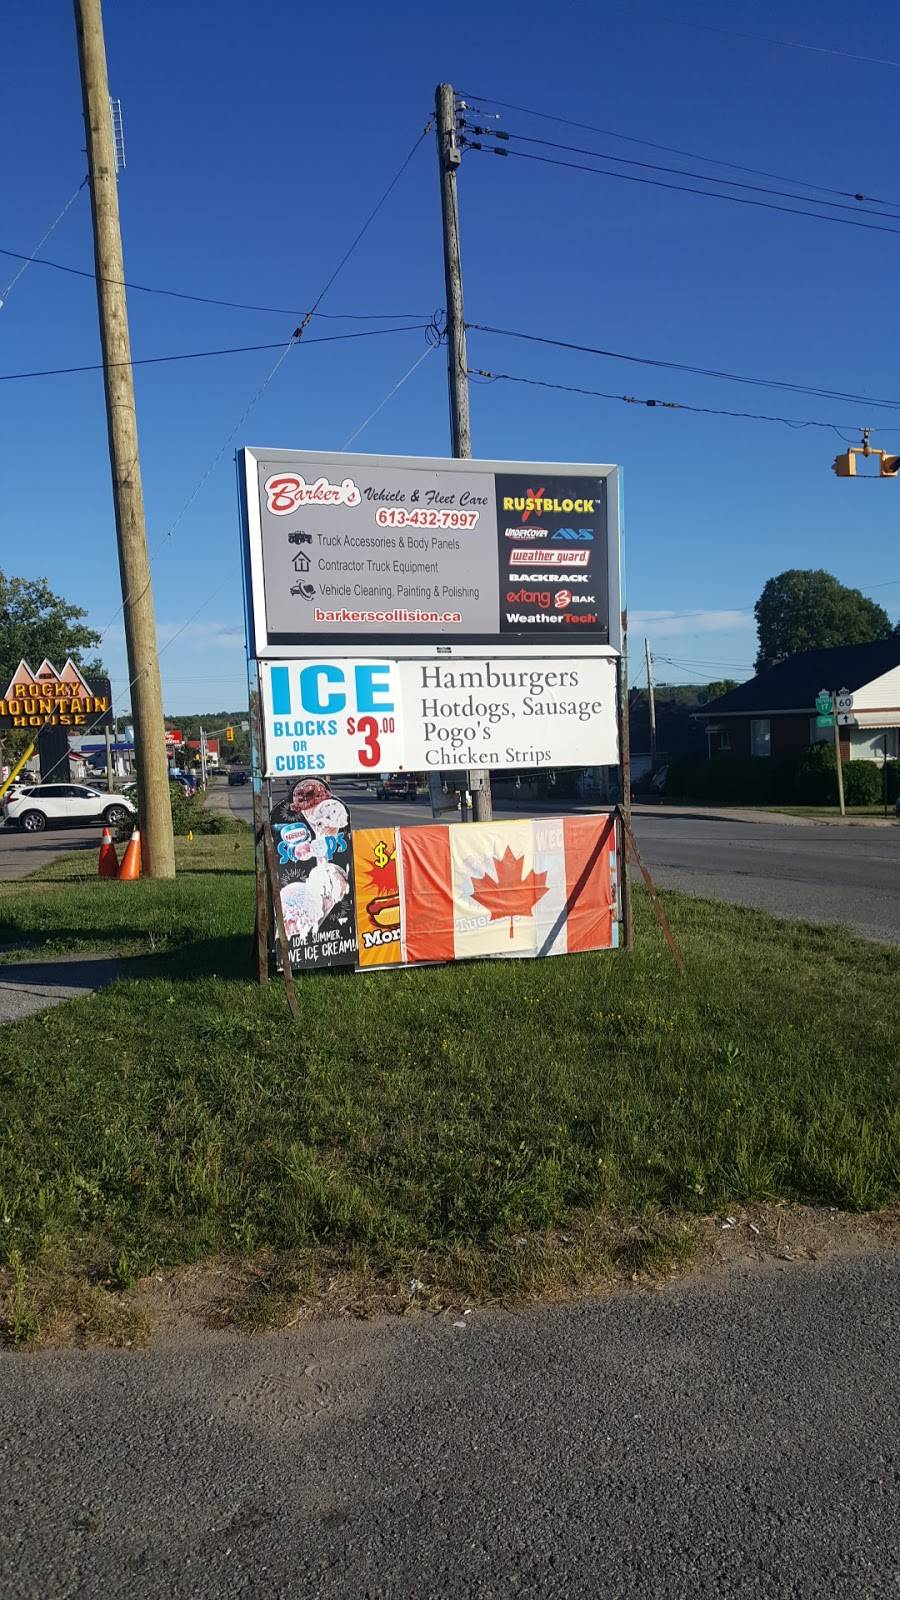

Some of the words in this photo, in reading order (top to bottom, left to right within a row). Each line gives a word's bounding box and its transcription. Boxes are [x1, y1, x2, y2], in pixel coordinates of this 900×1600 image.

[269, 478, 356, 511] Barker's
[364, 487, 405, 502] Vehicle
[410, 489, 420, 502] &
[424, 491, 455, 505] Fleet
[460, 491, 488, 506] Care
[503, 497, 594, 512] RUSTBLOCK
[378, 510, 477, 527] 613-432-7997
[317, 533, 342, 546] Truck
[344, 535, 396, 548] Accessories
[398, 537, 405, 548] &
[407, 537, 428, 551] Body
[431, 538, 460, 550] Panels
[512, 550, 555, 561] weather
[557, 550, 586, 563] guard
[318, 558, 364, 571] Contractor
[366, 560, 390, 572] Truck
[393, 560, 438, 574] Equipment
[509, 574, 588, 582] BACKRACK
[319, 584, 350, 597] Vehicle
[353, 585, 395, 599] Cleaning,
[397, 585, 431, 599] Painting
[433, 586, 440, 597] &
[442, 586, 480, 600] Polishing
[507, 588, 550, 608] extang
[314, 609, 462, 623] barkerscollision.ca
[506, 613, 596, 623] WeatherTech
[421, 662, 579, 695] Hamburgers
[15, 683, 80, 697] ROCKY
[271, 665, 394, 715] ICE
[422, 695, 516, 723] Hotdogs,
[523, 697, 602, 721] Sausage
[839, 698, 851, 707] 60
[13, 714, 87, 727] HOUSE
[273, 720, 337, 737] BLOCKS
[347, 716, 394, 767] $3.00
[424, 721, 491, 748] Pogo's
[293, 740, 308, 752] OR
[275, 754, 326, 772] CUBES
[425, 747, 499, 765] Chicken
[506, 746, 552, 766] Strips
[305, 945, 320, 962] ICE
